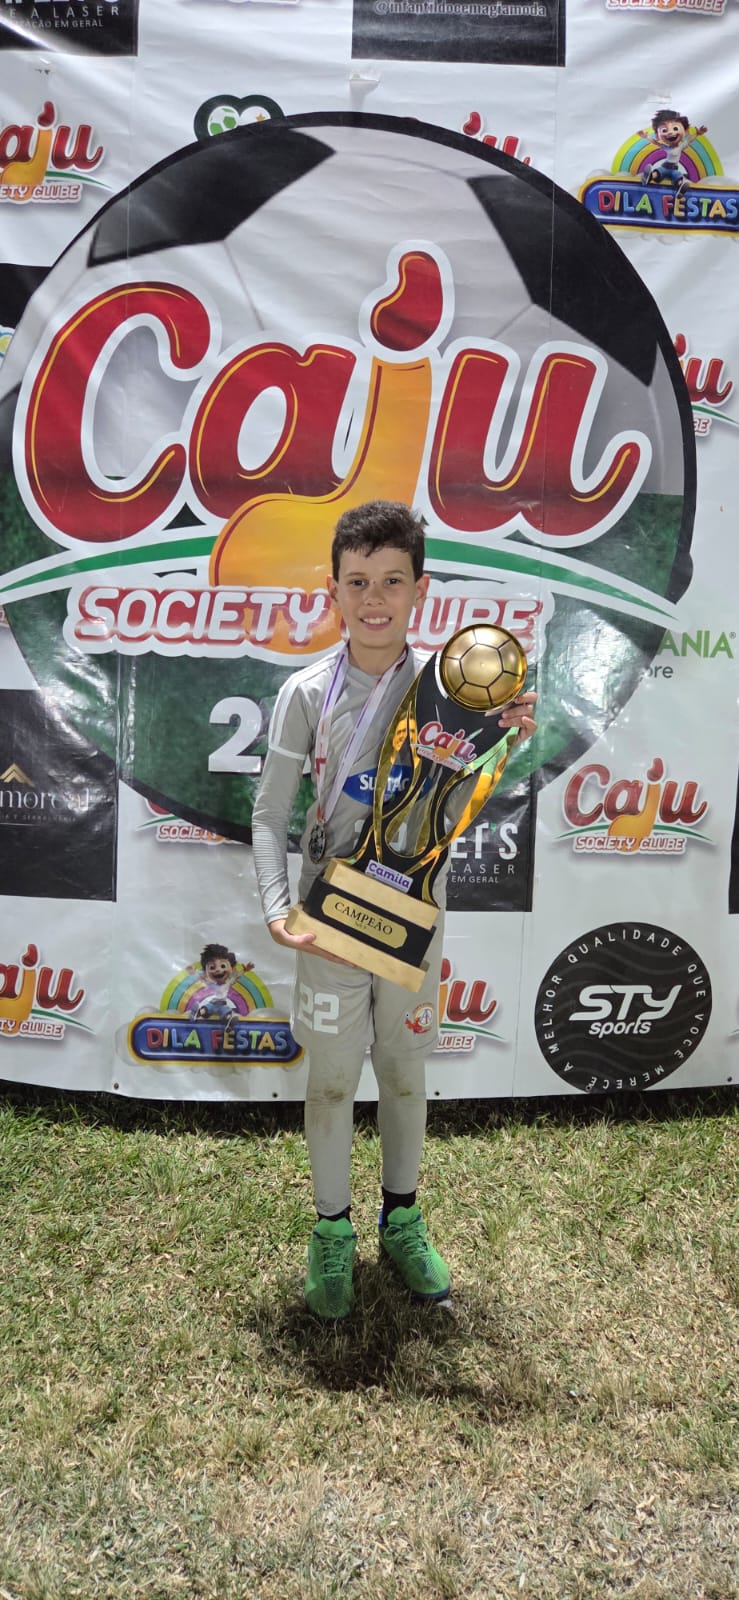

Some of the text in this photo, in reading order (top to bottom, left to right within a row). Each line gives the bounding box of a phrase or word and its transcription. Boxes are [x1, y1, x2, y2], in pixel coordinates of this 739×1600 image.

[53, 6, 119, 18] LASER
[72, 20, 104, 28] GERAL
[0, 101, 104, 182] aju
[33, 185, 80, 199] CLUBE
[598, 190, 738, 219] DILA FESTAS
[25, 251, 641, 588] Caju
[78, 587, 329, 647] SOCIETY
[418, 722, 477, 762] Caju
[564, 758, 708, 837] Caju
[576, 836, 684, 851] SOCIETY CLUBE
[368, 862, 410, 888] Camila
[450, 863, 515, 874] LASER
[468, 876, 499, 884] GERAL
[334, 901, 393, 936] CAMPEÃO
[567, 929, 682, 965] QUALIDADE
[687, 963, 706, 998] QUE
[297, 982, 339, 1034] 22
[542, 975, 563, 1055] MELHOR
[568, 984, 683, 1021] STY
[20, 1021, 63, 1037] CLUBE
[146, 1028, 288, 1051] DILA FESTAS
[588, 1017, 652, 1039] sports
[589, 1064, 665, 1089] MERECE
